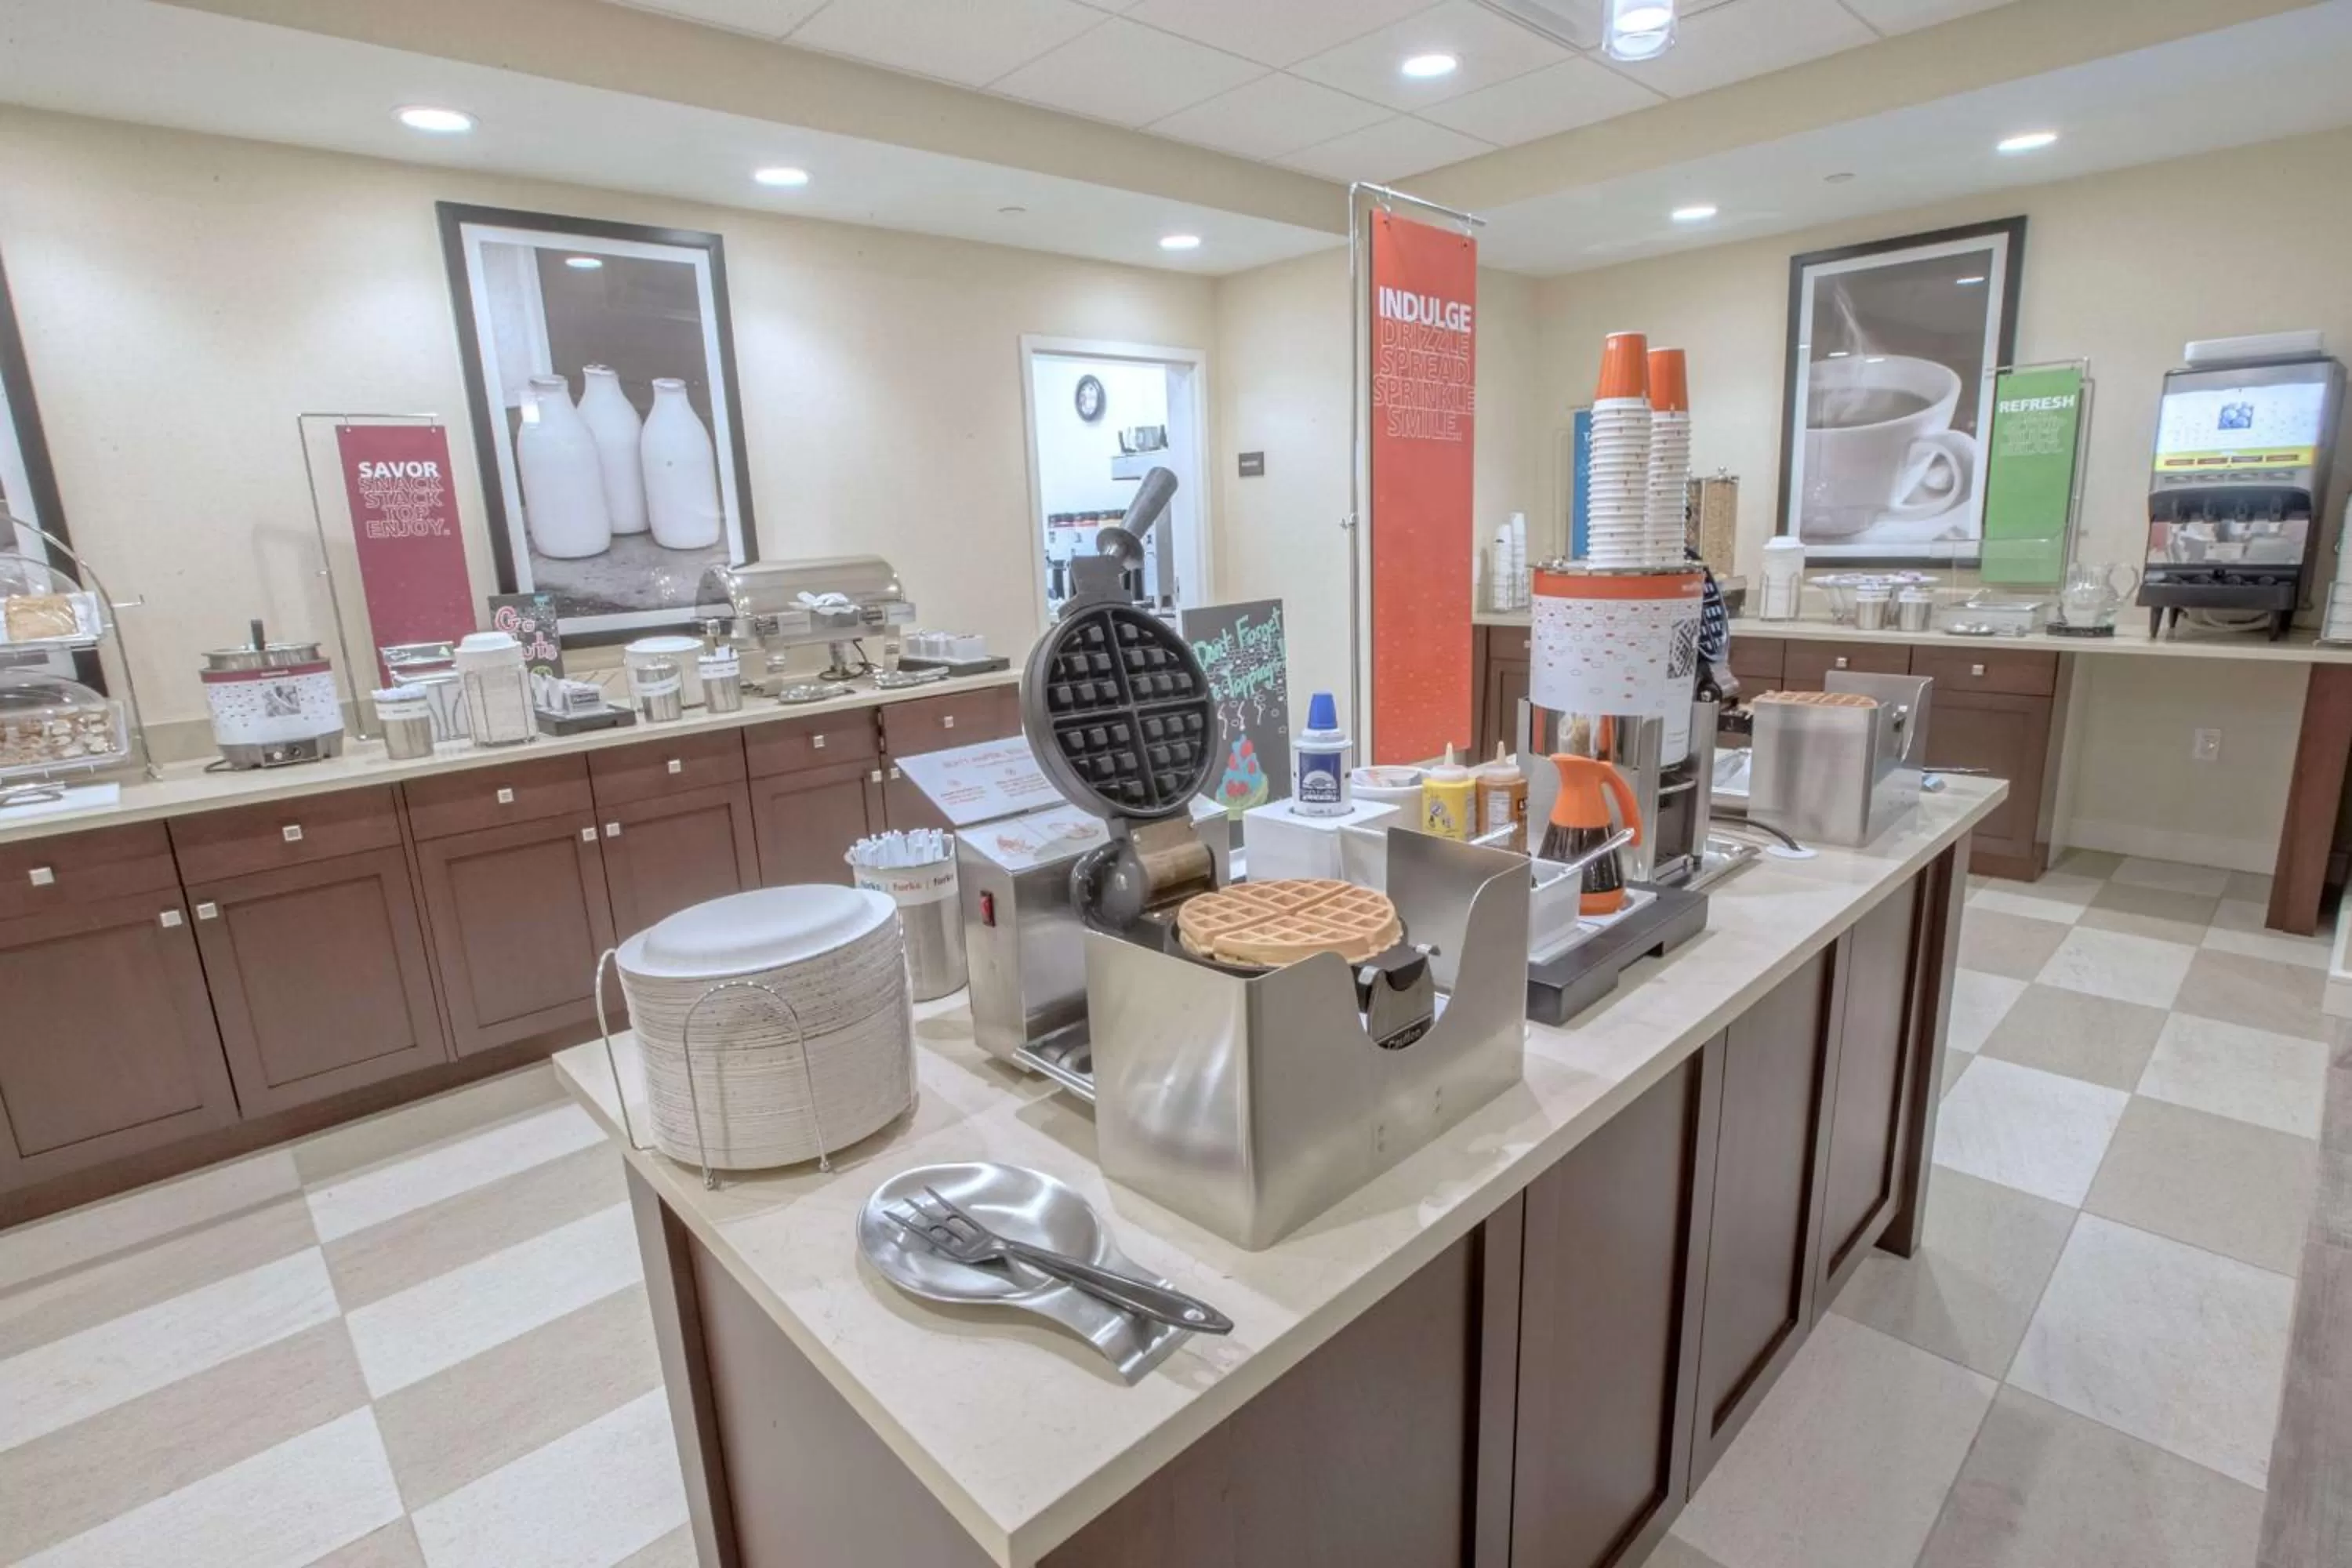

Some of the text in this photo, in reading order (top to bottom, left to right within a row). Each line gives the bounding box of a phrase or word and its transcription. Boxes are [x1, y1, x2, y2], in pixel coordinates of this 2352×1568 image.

[1379, 286, 1472, 333] INDULGE
[1381, 318, 1471, 359] DRIZZLE
[1380, 347, 1471, 385] SPREAD
[1373, 374, 1475, 415] SPRINKLE
[1998, 394, 2076, 413] REFRESH
[358, 461, 440, 477] SAVOR
[358, 475, 445, 493] SNACK
[364, 490, 445, 508] STACK
[381, 504, 430, 521] TOP
[366, 517, 451, 539] ENJOY.
[1236, 606, 1279, 652] Forget
